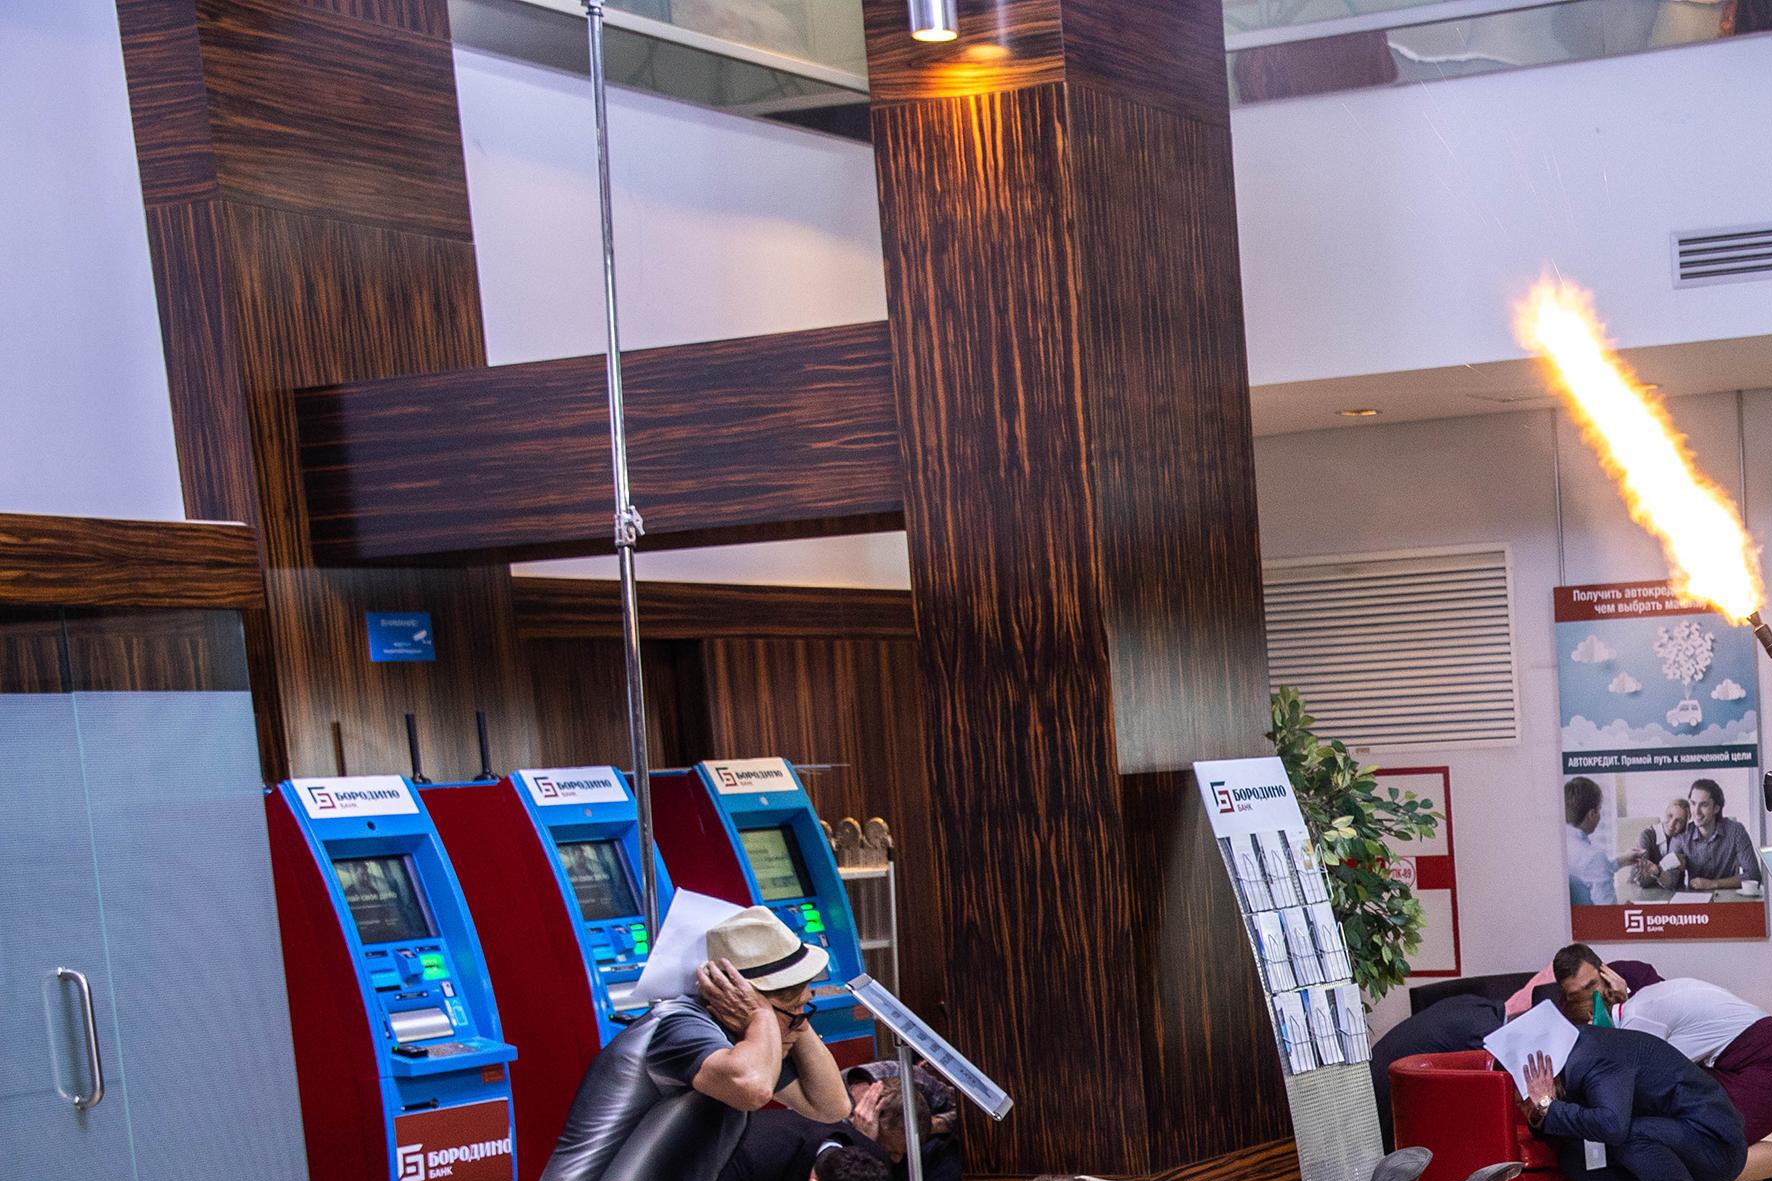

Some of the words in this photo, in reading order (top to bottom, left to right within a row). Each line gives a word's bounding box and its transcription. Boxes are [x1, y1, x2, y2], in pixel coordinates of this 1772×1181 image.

[1573, 588, 1622, 602] Получить
[1624, 585, 1674, 599] автокред
[1594, 604, 1616, 614] чем
[1618, 601, 1662, 613] выбрать
[1568, 756, 1620, 768] АВТОКРЕДИТ.
[1621, 754, 1652, 766] Прямой
[1654, 755, 1672, 766] путь
[1731, 752, 1753, 762] цели
[335, 789, 400, 802] БОРОДИНО
[1232, 784, 1287, 801] БОРОДИНО
[1237, 803, 1253, 812] БАНК
[1646, 914, 1709, 926] БОРОДИНО
[427, 1138, 512, 1168] БОРОДИНО
[428, 1166, 453, 1179] БАНК
